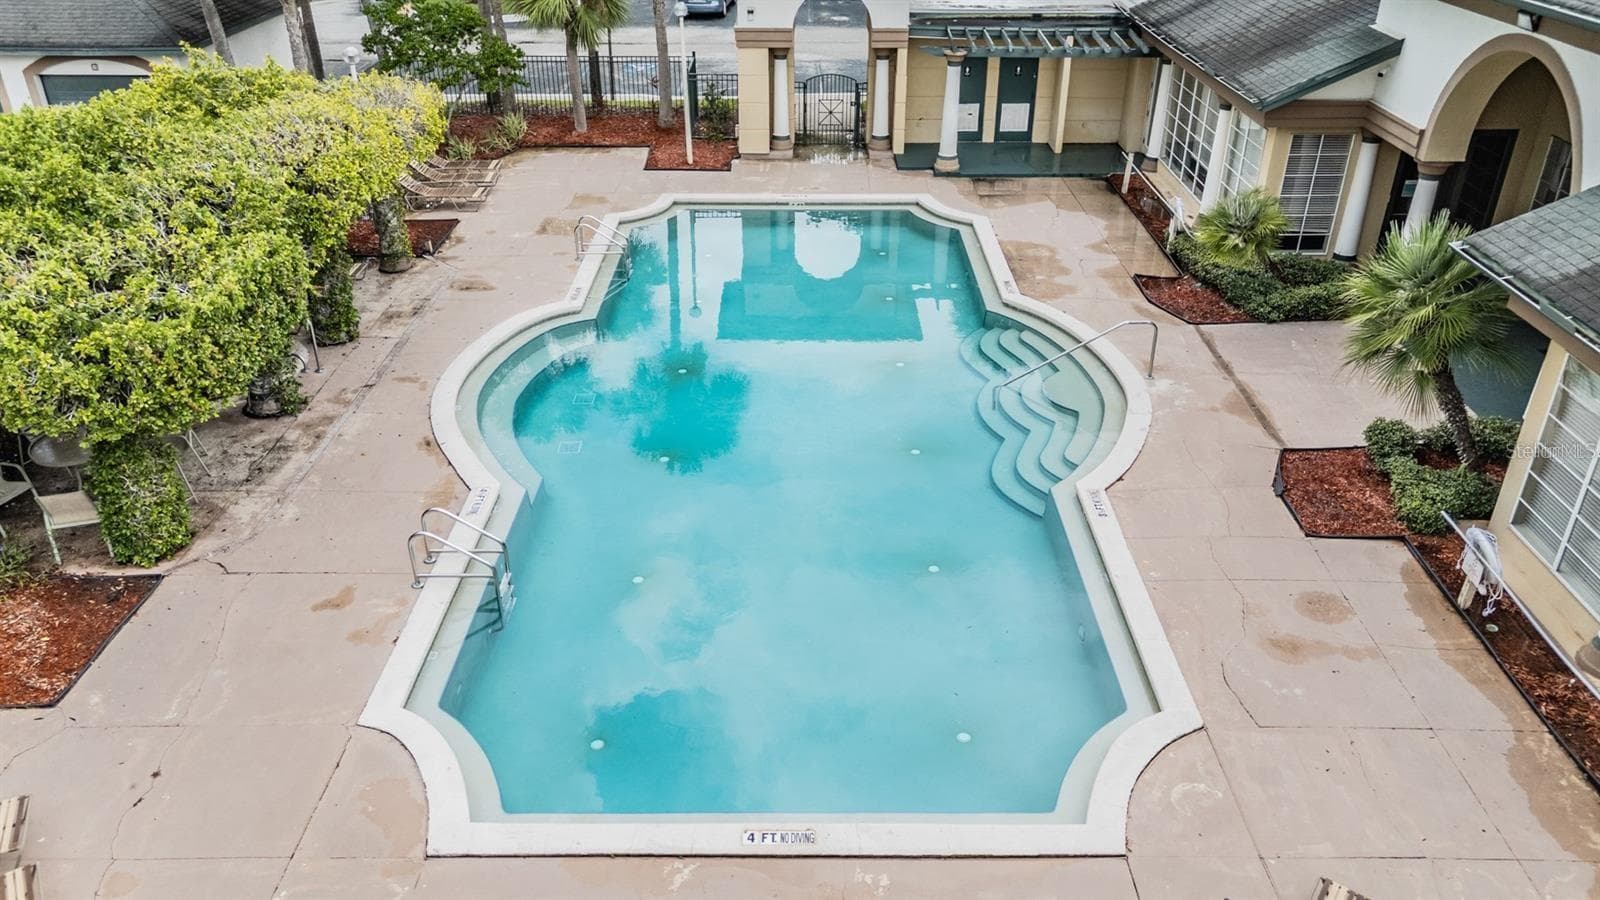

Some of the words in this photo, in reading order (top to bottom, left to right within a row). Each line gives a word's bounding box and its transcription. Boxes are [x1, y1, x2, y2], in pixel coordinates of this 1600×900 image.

[747, 832, 755, 843] 4
[780, 832, 789, 844] NO
[790, 832, 815, 844] DIVING
